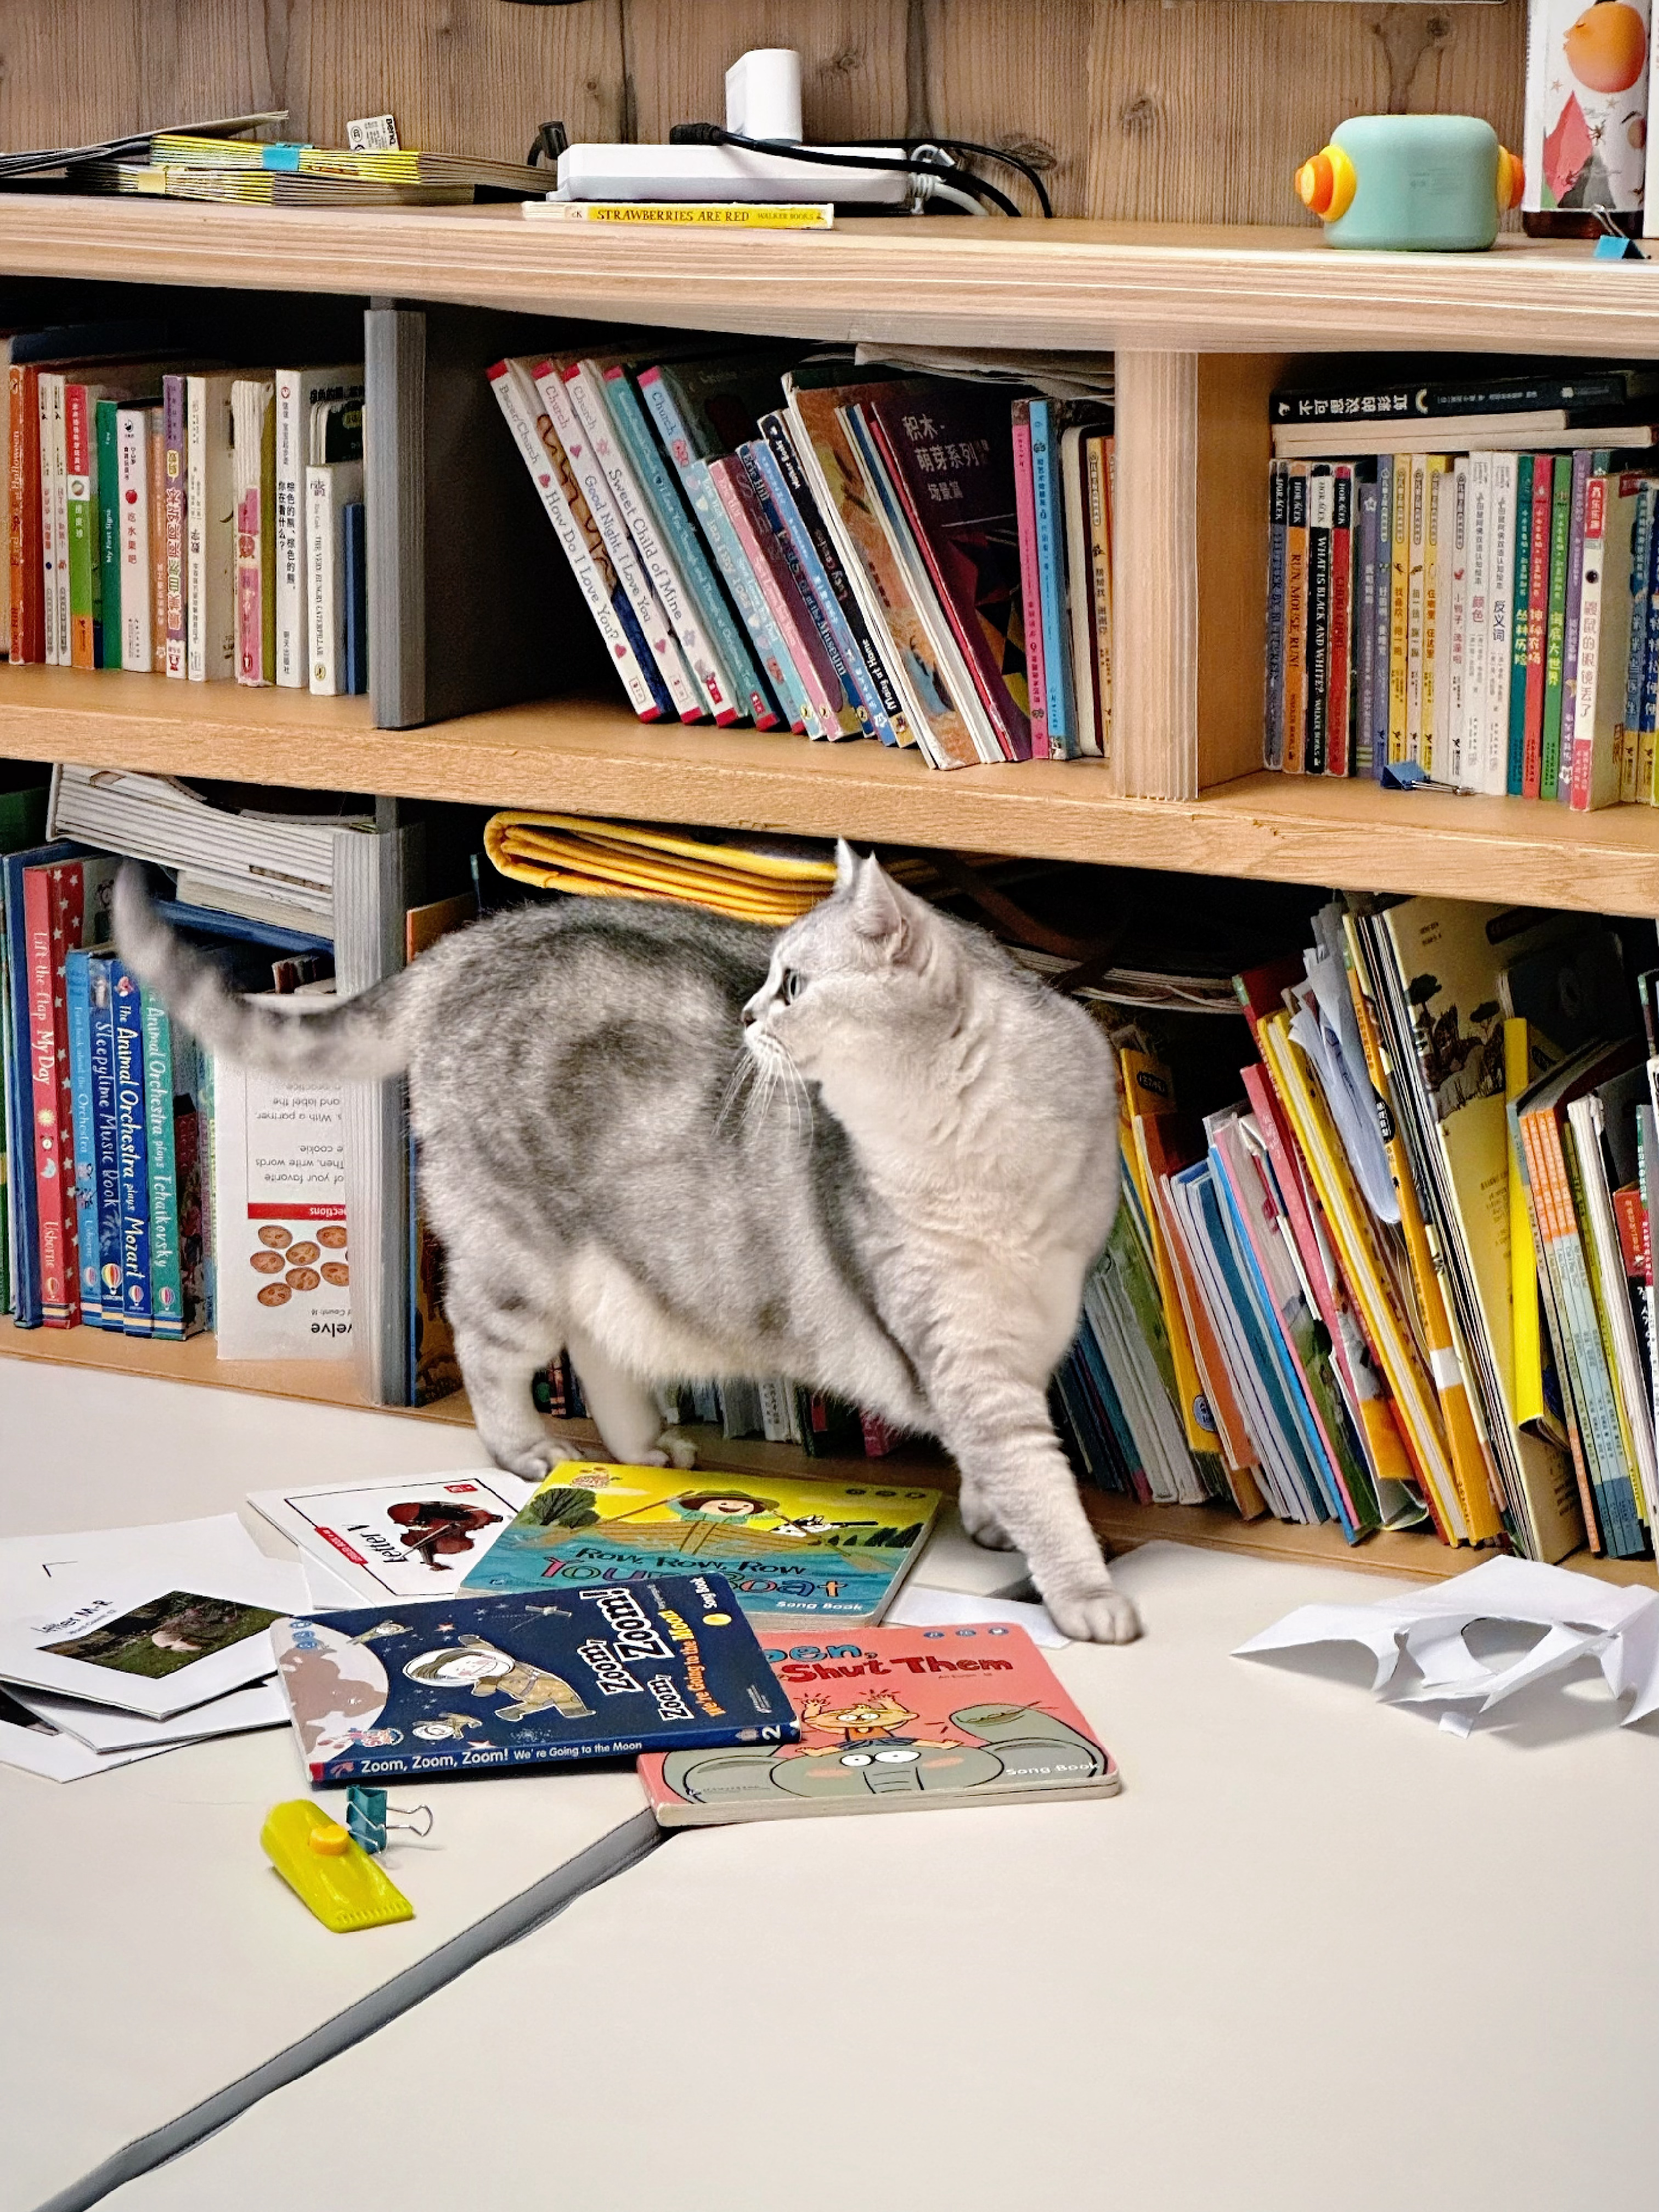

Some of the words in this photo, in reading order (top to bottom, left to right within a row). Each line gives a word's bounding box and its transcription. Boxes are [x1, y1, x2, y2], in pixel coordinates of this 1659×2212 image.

[597, 209, 693, 222] STRAWBERRIES
[697, 210, 721, 222] ARE
[725, 210, 749, 222] RED
[573, 385, 597, 431] Church
[652, 392, 676, 436] Church
[545, 385, 569, 429] Church
[584, 475, 607, 511] Good
[622, 563, 639, 596] Love
[637, 595, 651, 623] You
[608, 469, 637, 515] Sweet
[546, 490, 566, 527] How
[562, 527, 577, 552] Do
[632, 518, 658, 560] Child
[1317, 536, 1327, 573] WHAT
[574, 554, 586, 564] I
[651, 562, 668, 577] of
[742, 451, 761, 479] Eric
[754, 478, 769, 500] Hill
[820, 620, 848, 676] Museum
[579, 566, 599, 603] Love
[1317, 573, 1327, 585] IS
[659, 579, 682, 620] Mine
[1316, 586, 1326, 621] BLACK
[597, 602, 620, 639] You?
[1316, 624, 1325, 647] AND
[1493, 600, 1506, 642] 反义词
[862, 638, 877, 668] Home
[1315, 647, 1325, 693] WHITE?
[31, 1030, 55, 1053] My
[146, 1006, 166, 1058] Animal
[32, 1057, 56, 1085] Day
[93, 1021, 115, 1108] Sleepytime
[117, 1027, 140, 1086] Animal
[149, 1059, 168, 1135] Orchestra
[292, 1098, 317, 1107] label
[320, 1098, 340, 1107] and
[119, 1089, 142, 1178] Orchestra
[309, 1113, 332, 1122] With
[99, 1113, 117, 1164] Music
[154, 1140, 167, 1168] plays
[255, 1159, 285, 1167] words
[264, 1174, 303, 1184] favorite
[307, 1173, 330, 1182] your
[101, 1169, 121, 1208] Book
[334, 1175, 345, 1184] of
[122, 1183, 136, 1211] plays
[153, 1175, 173, 1267] Tchaikovsky
[43, 1221, 59, 1268] Usborne
[123, 1216, 146, 1279] Mozart
[575, 1546, 645, 1565] Row,
[656, 1555, 729, 1572] Row,
[737, 1560, 809, 1576] Row
[689, 1576, 709, 1594] Book
[702, 1592, 719, 1610] Song
[775, 1600, 817, 1610] Song
[822, 1602, 865, 1612] Book
[579, 1586, 676, 1662] Zoom!
[657, 1608, 696, 1642] Moon
[679, 1639, 699, 1655] the
[682, 1664, 707, 1691] Going
[780, 1657, 891, 1683] Shut
[889, 1655, 1014, 1674] Them
[761, 1724, 782, 1741] 2
[360, 1758, 409, 1774] Zoom,
[411, 1753, 458, 1770] Zoom,
[461, 1748, 509, 1765] Zoom!
[549, 1745, 580, 1759] Going
[582, 1745, 592, 1754] to
[594, 1742, 610, 1753] the
[612, 1740, 643, 1752] Moon
[1006, 1765, 1052, 1776] Song
[1055, 1761, 1101, 1773] Book
